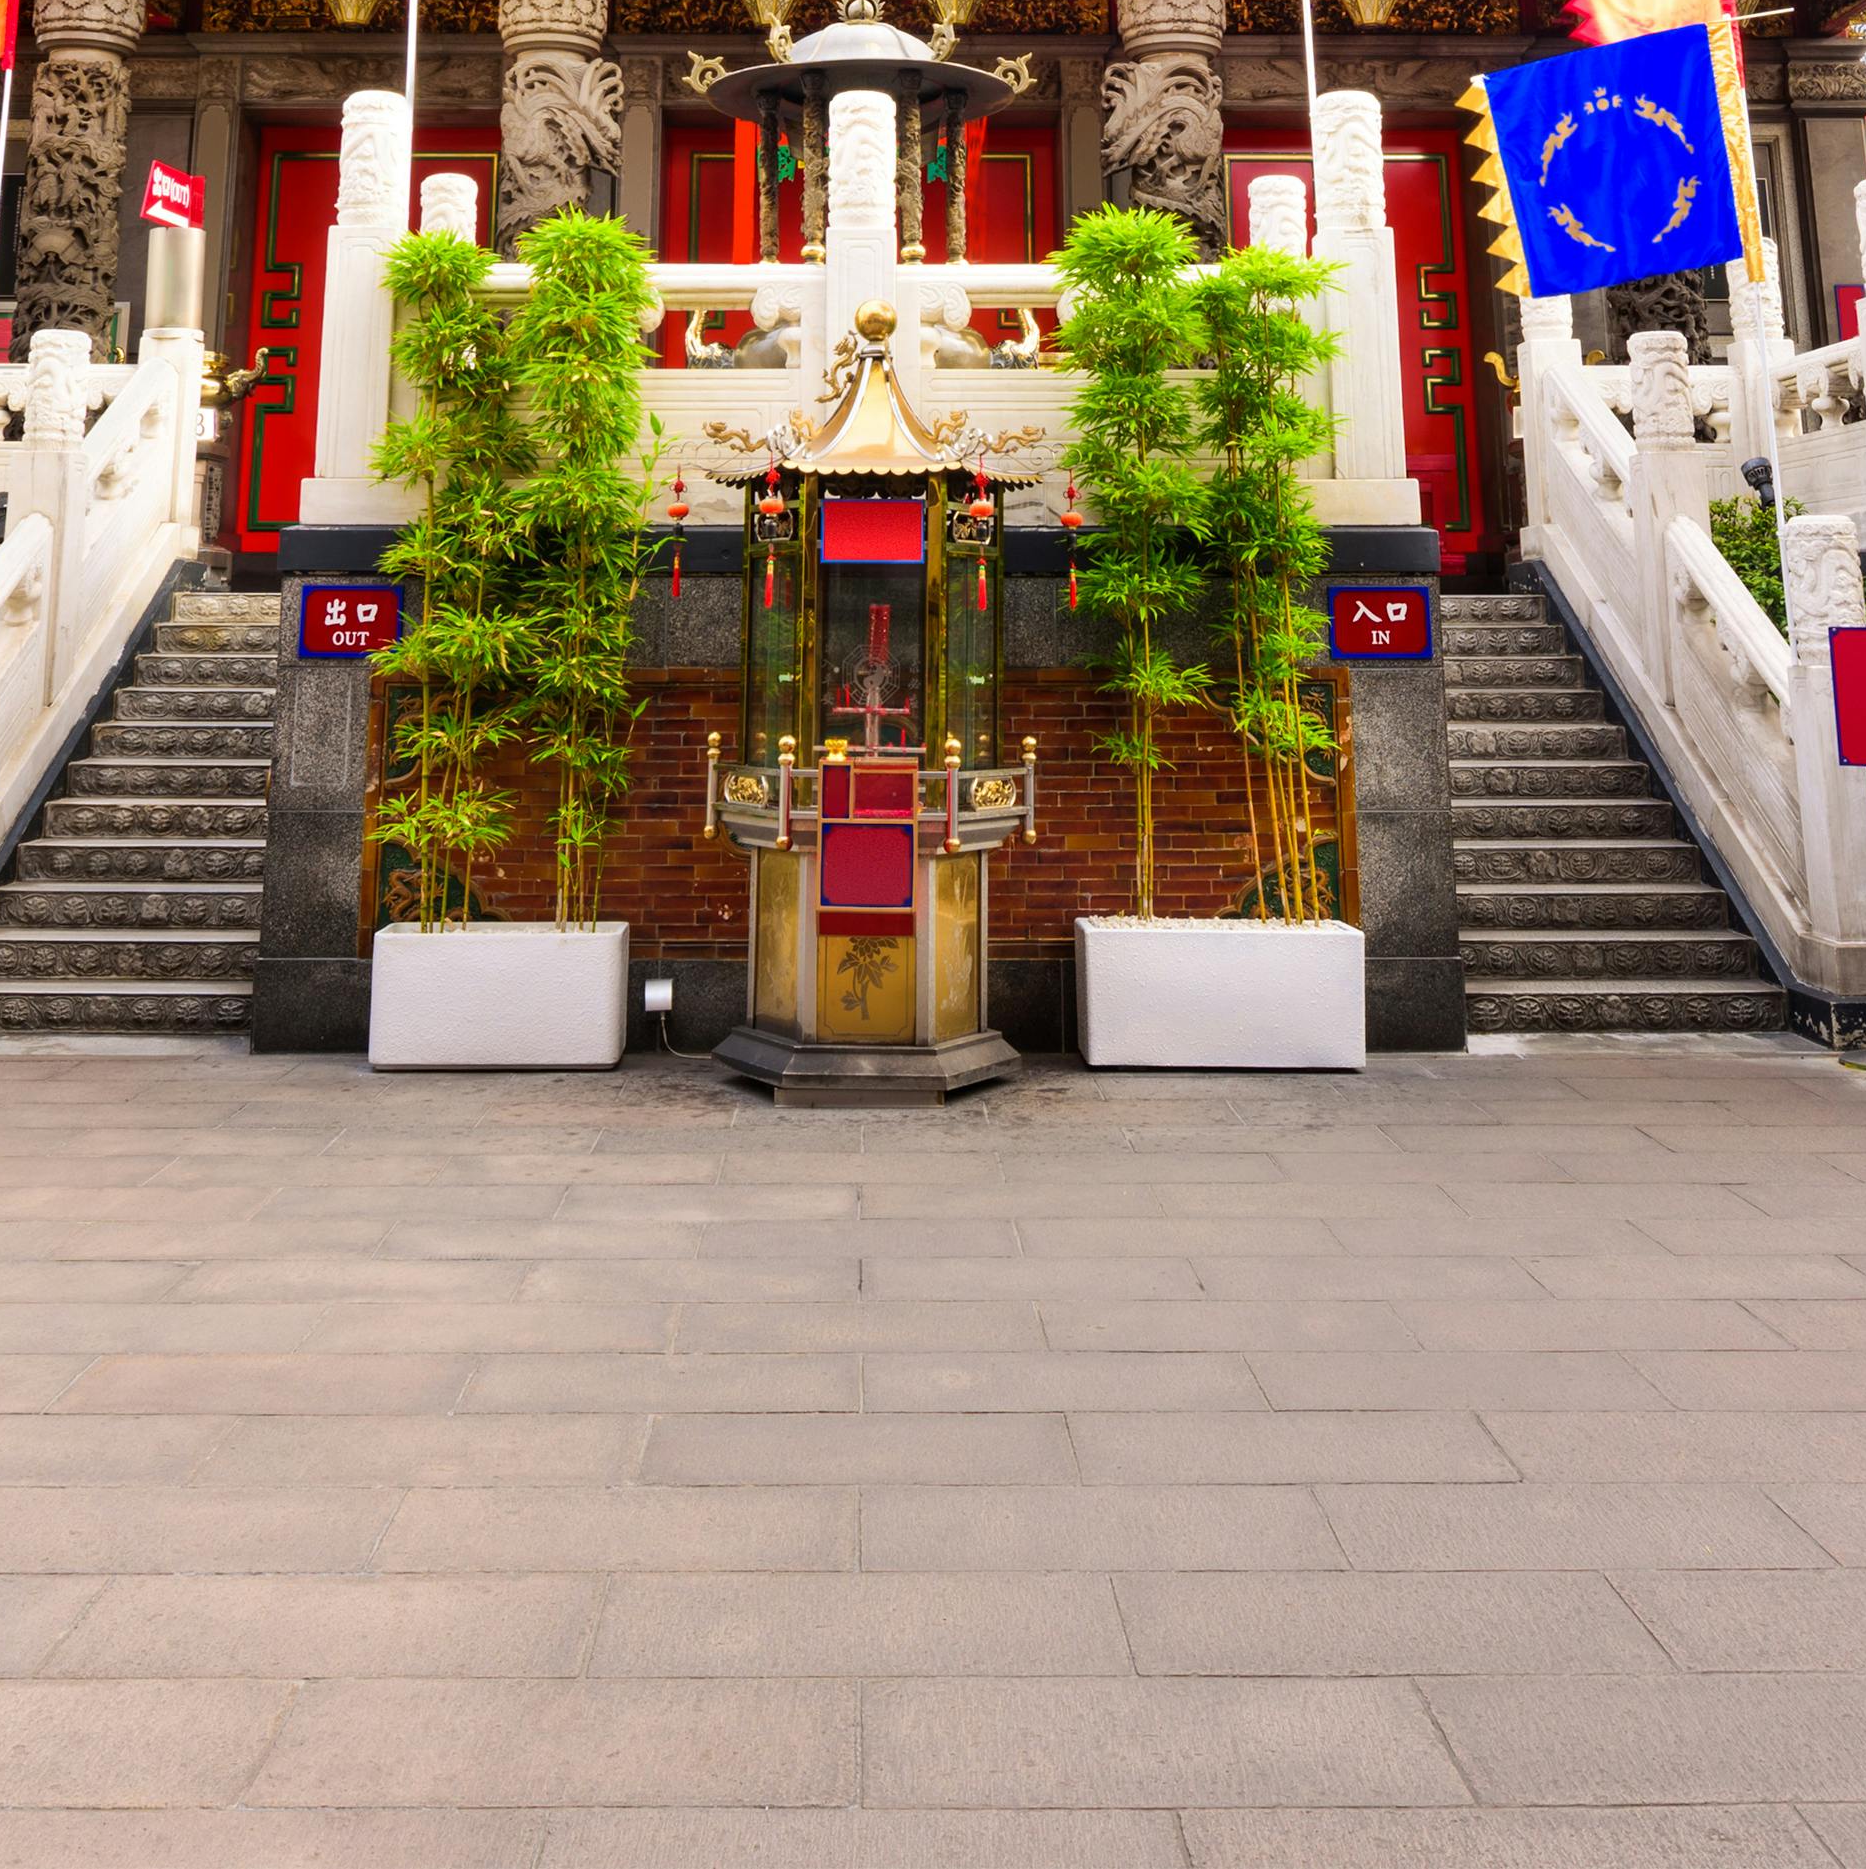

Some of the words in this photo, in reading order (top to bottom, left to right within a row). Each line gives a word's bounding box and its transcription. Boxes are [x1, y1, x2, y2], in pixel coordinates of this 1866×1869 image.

[324, 598, 379, 626] 出口
[1352, 600, 1408, 623] 入口
[332, 631, 370, 646] OUT
[1371, 630, 1390, 645] IN
